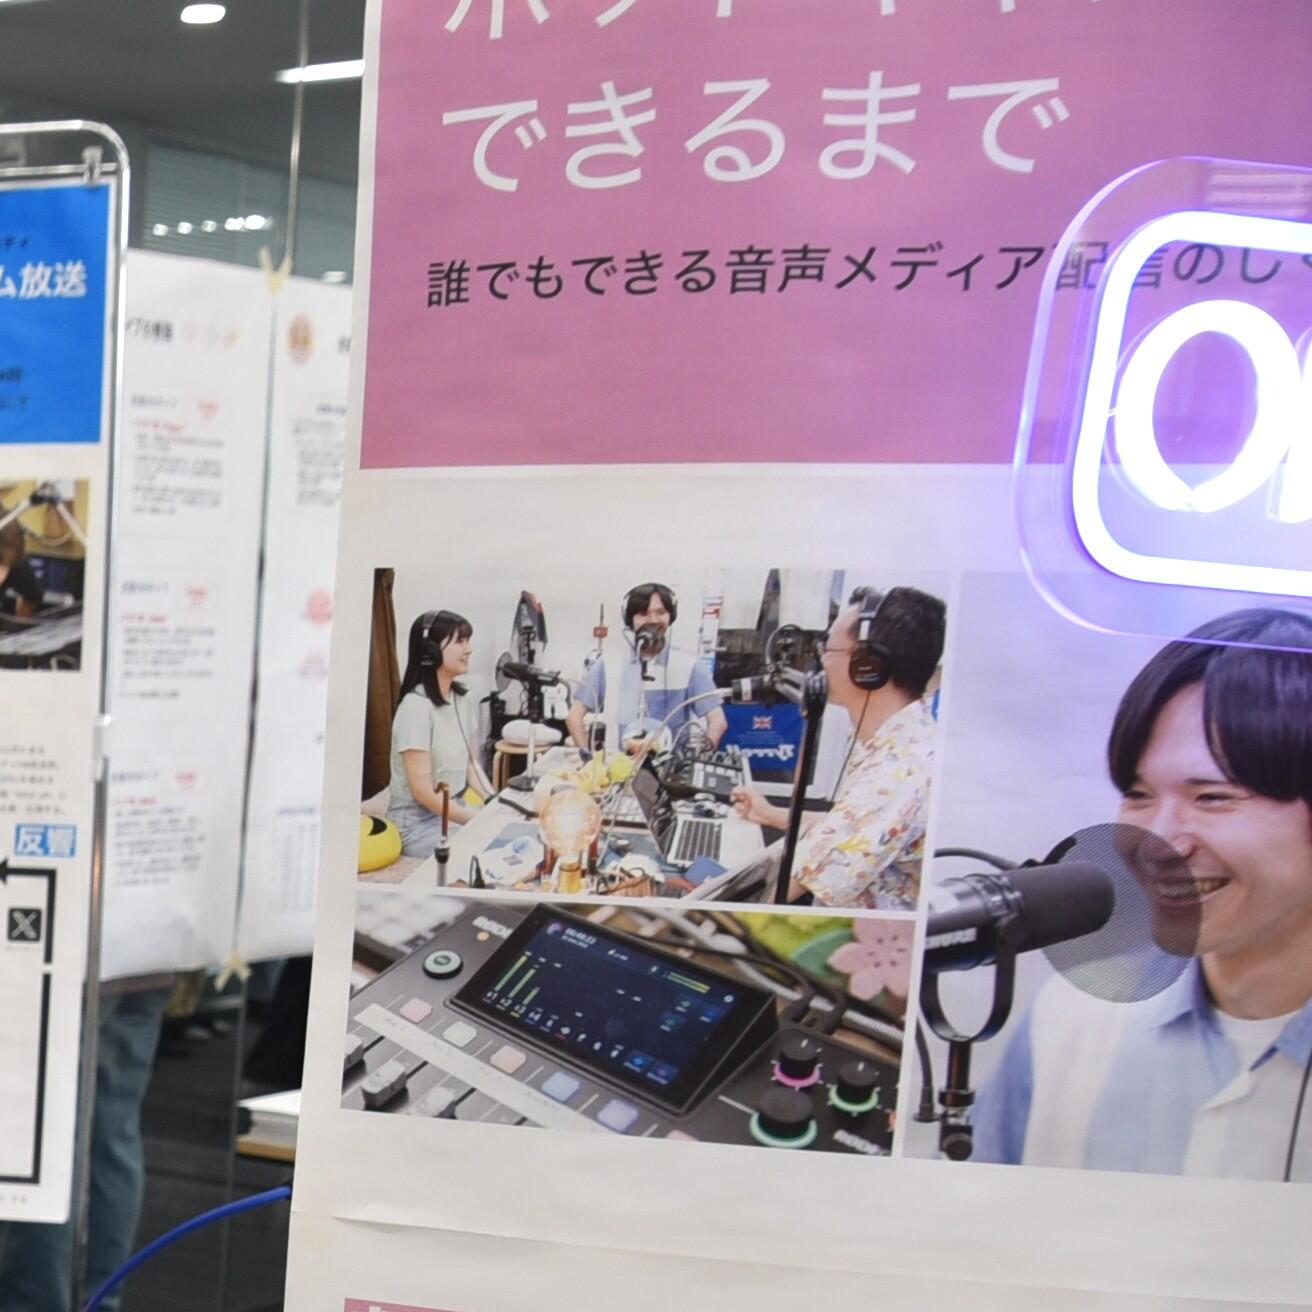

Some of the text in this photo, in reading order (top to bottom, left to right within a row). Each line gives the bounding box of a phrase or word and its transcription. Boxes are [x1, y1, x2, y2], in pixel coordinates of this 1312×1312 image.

[442, 70, 1070, 193] できるまで
